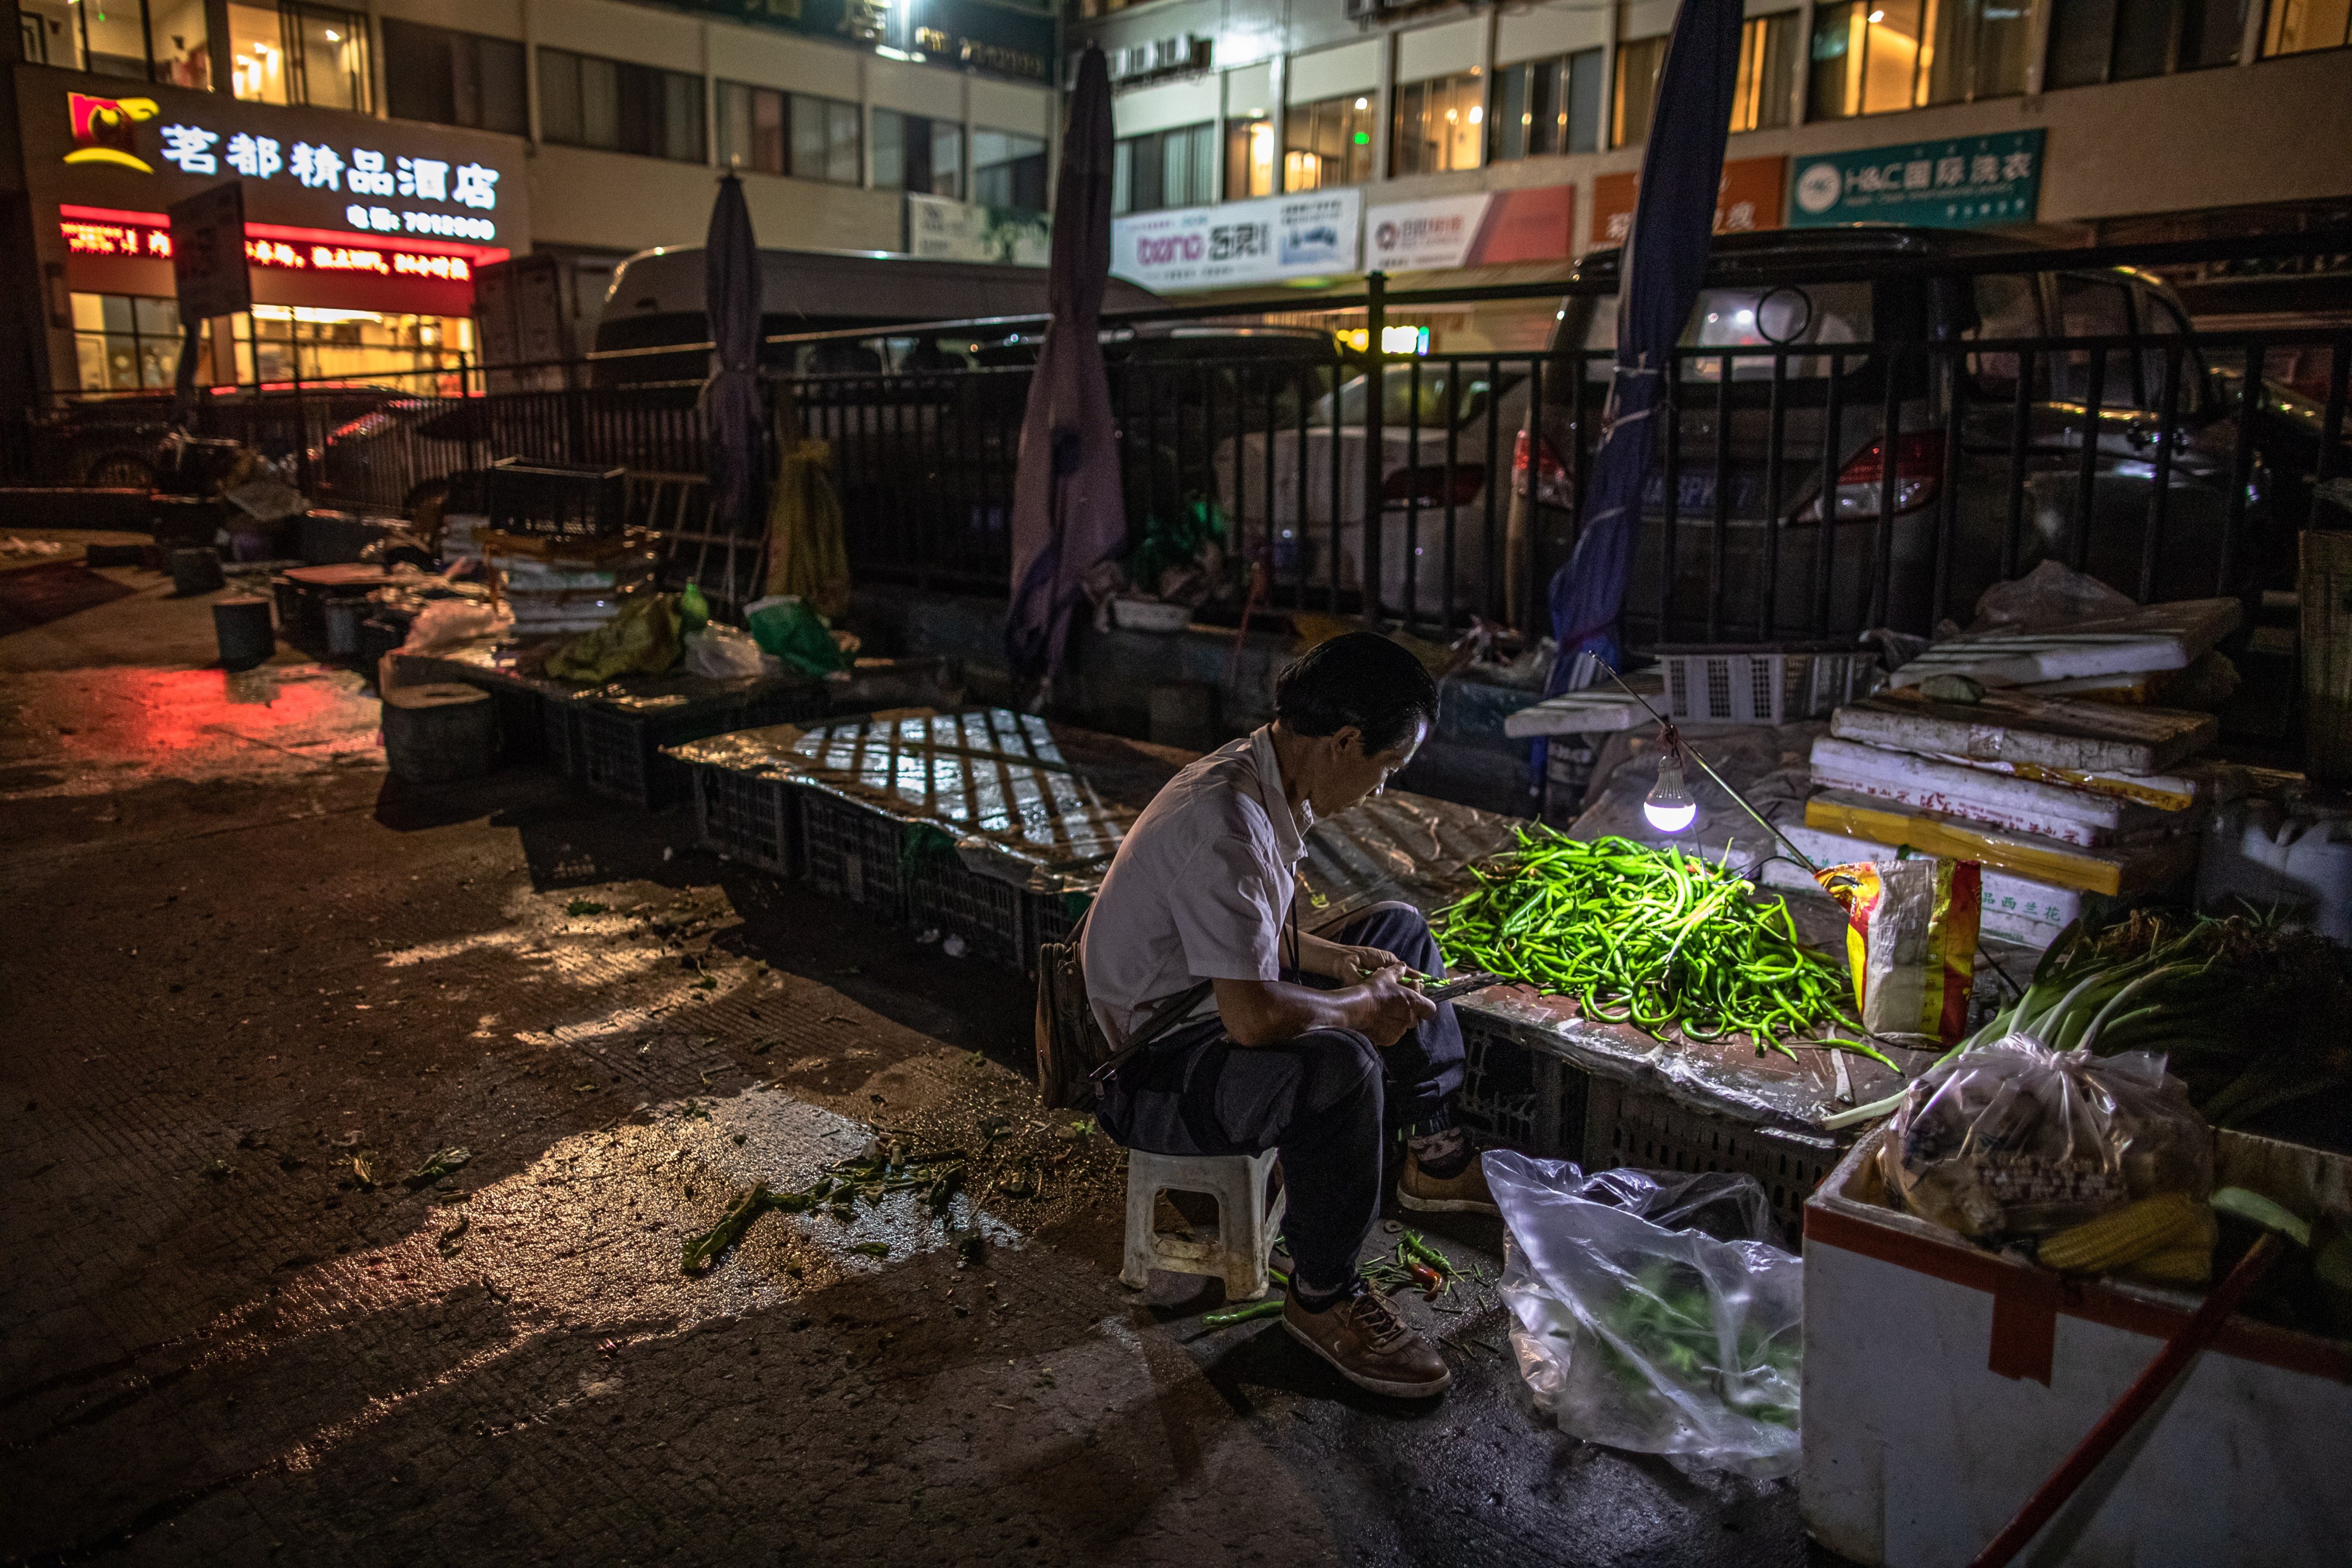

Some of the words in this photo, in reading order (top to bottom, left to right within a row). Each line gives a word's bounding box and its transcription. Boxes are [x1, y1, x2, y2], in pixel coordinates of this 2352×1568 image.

[160, 123, 500, 210] 茗都精品酒店
